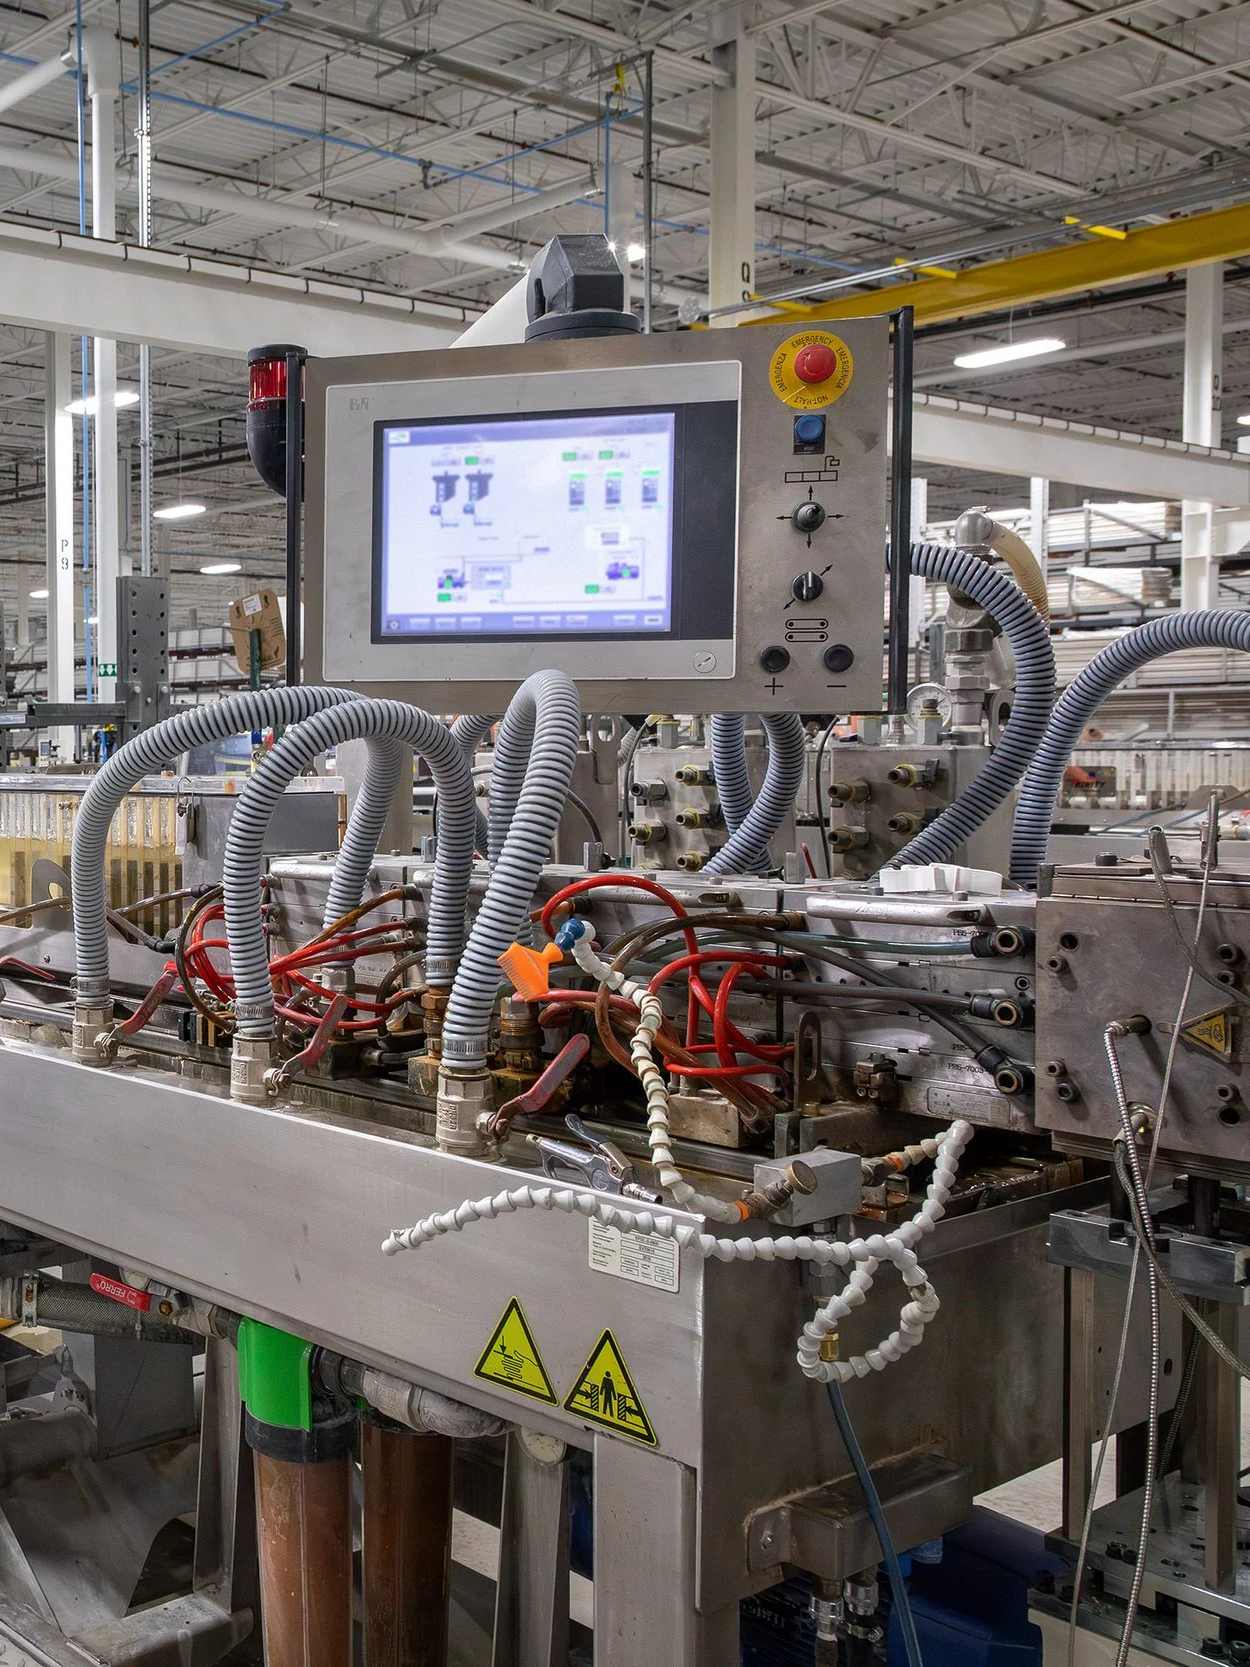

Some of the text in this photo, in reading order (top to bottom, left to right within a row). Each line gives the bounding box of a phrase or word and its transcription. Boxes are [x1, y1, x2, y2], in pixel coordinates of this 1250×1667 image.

[791, 334, 834, 349] EMERGENCY
[774, 352, 788, 393] EMERGENZA
[793, 394, 829, 406] NOT-HALT
[99, 1280, 127, 1298] FERRO
